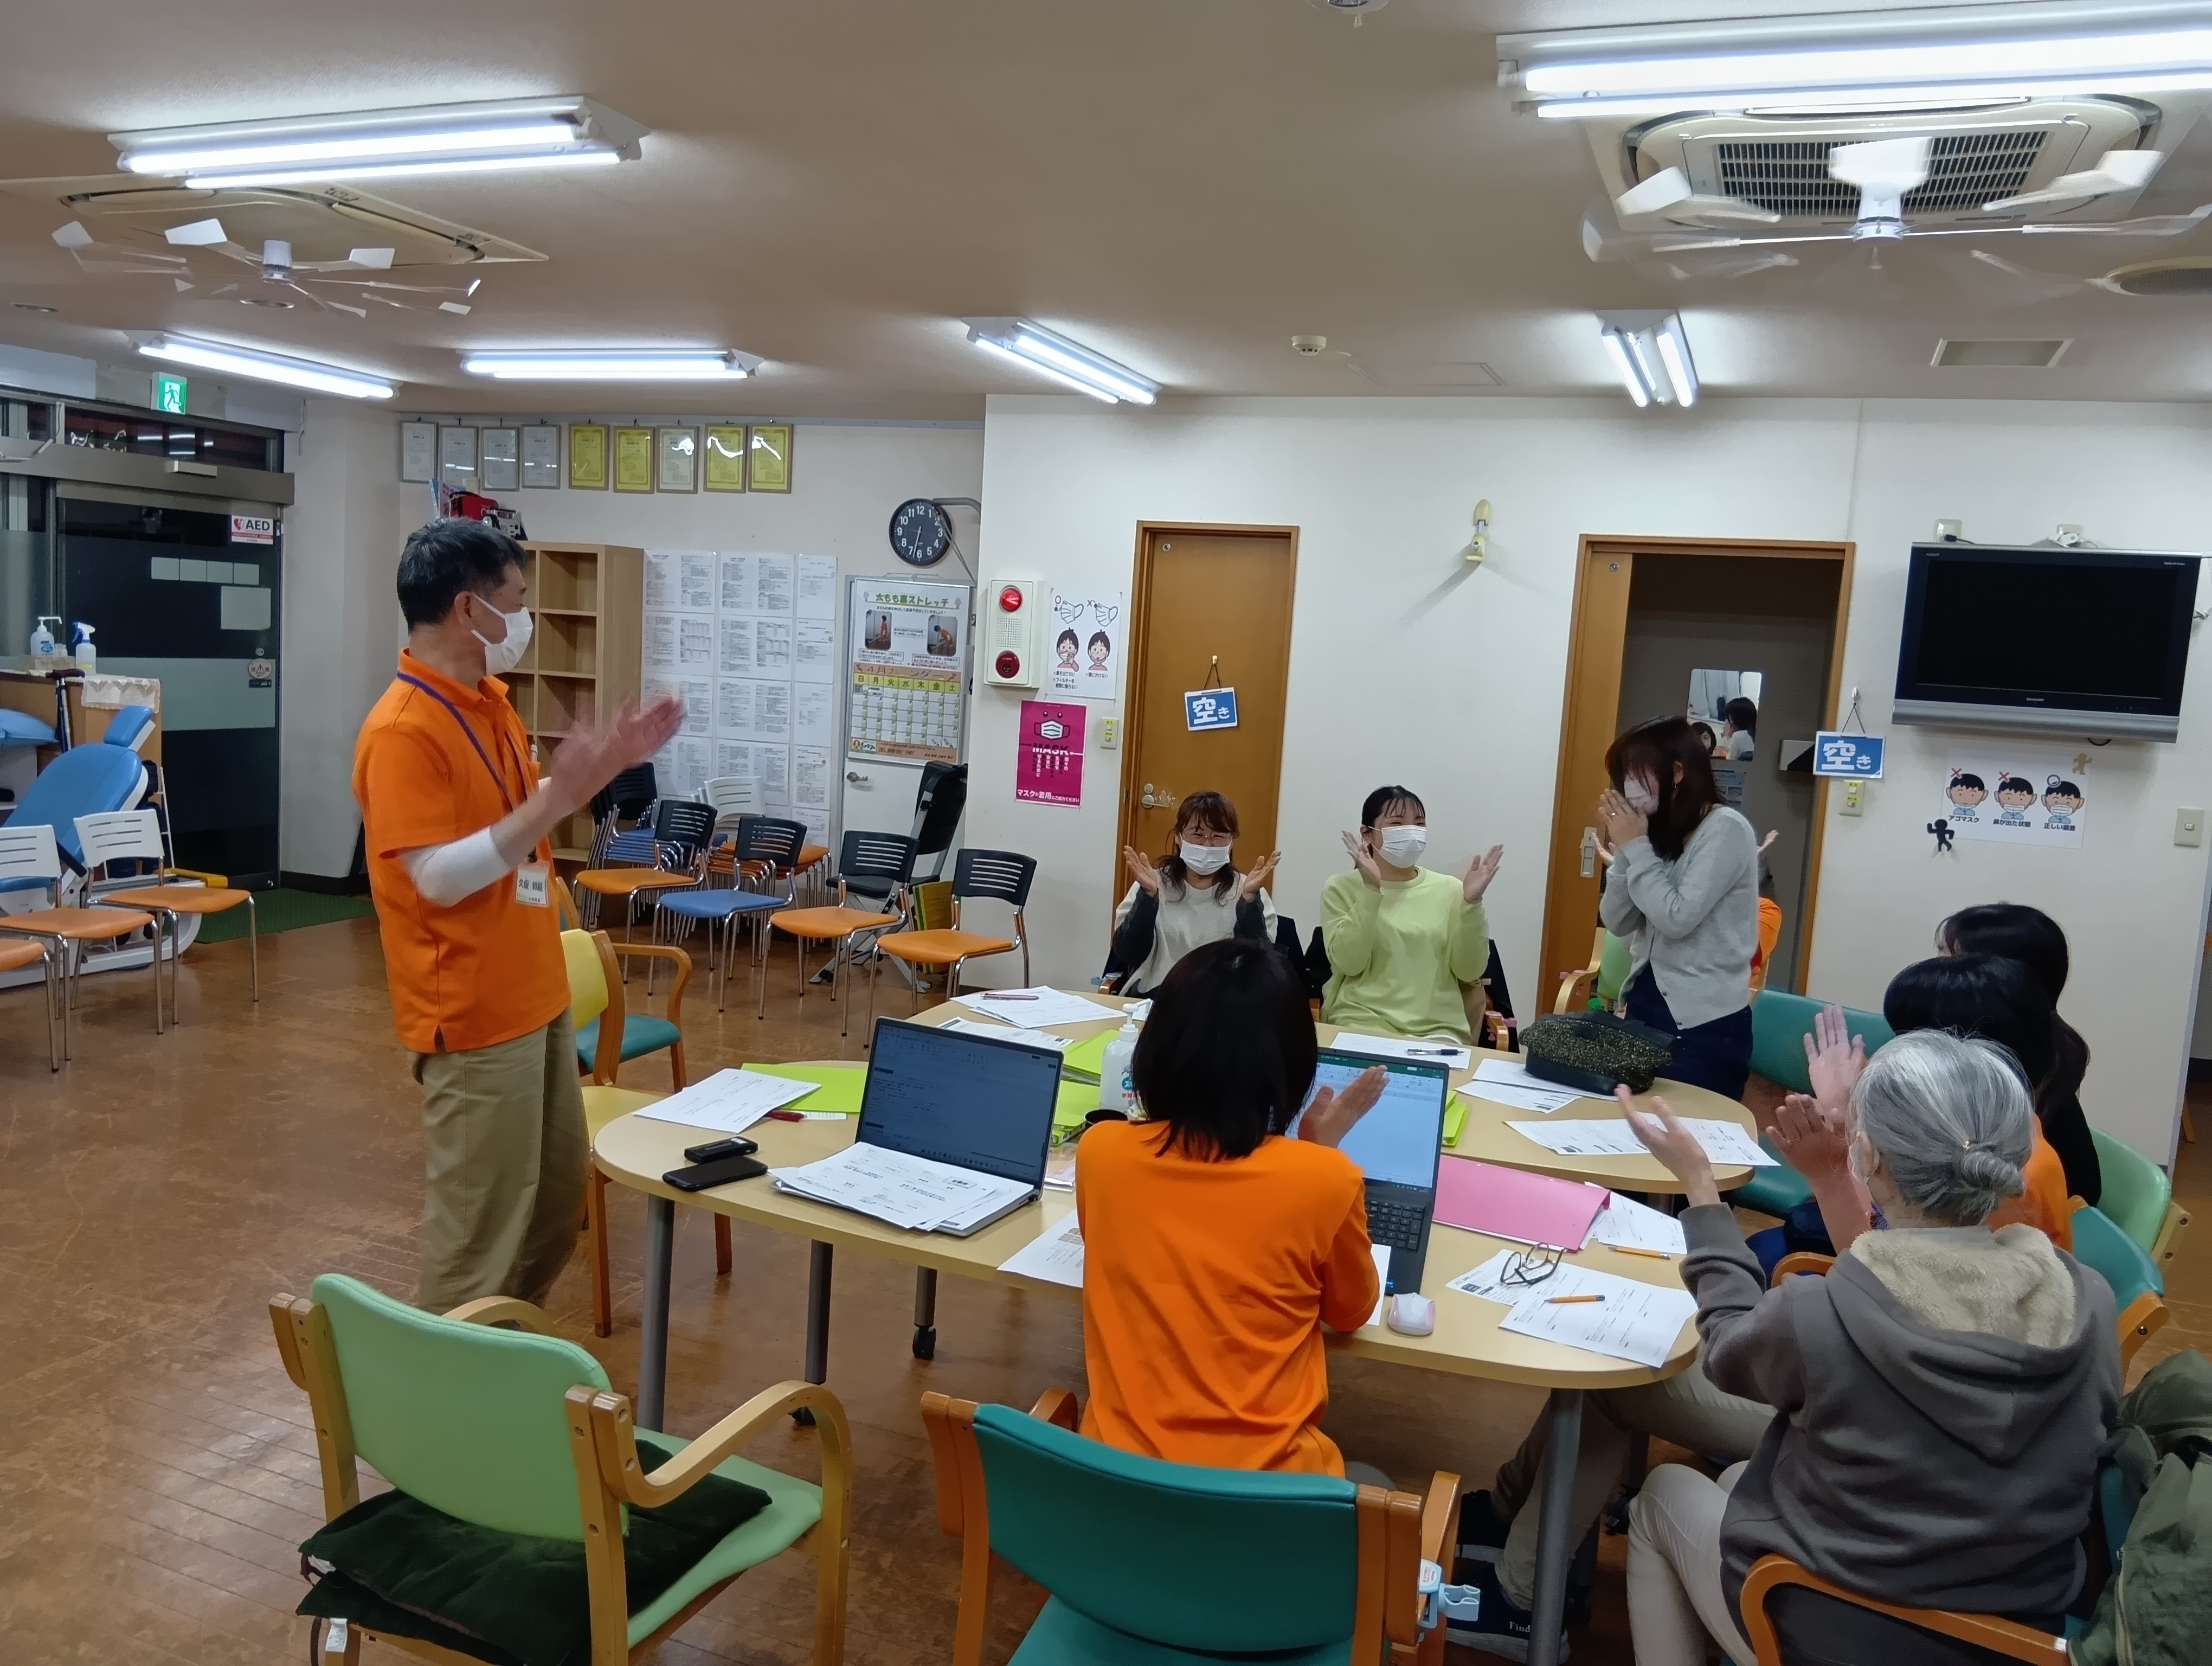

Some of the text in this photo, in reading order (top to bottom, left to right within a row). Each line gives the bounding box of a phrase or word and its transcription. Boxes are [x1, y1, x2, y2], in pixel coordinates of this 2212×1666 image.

[908, 508, 915, 518] 11
[916, 505, 925, 515] 12
[928, 509, 931, 518] 1
[900, 516, 908, 525] 10
[246, 520, 270, 531] AED
[897, 527, 902, 536] 9
[937, 528, 943, 537] 3
[902, 538, 906, 547] 8
[934, 539, 939, 548] 4
[908, 546, 914, 555] 7
[917, 549, 922, 559] 6
[927, 547, 932, 555] 5
[876, 593, 949, 607] 太もも裏ストレッチ
[933, 682, 940, 690] 金
[1192, 696, 1230, 725] 空き
[1032, 742, 1069, 755] MASK
[1821, 740, 1872, 770] 空き
[1949, 815, 1979, 823] アゴマスク
[2043, 823, 2076, 831] 正しい装着
